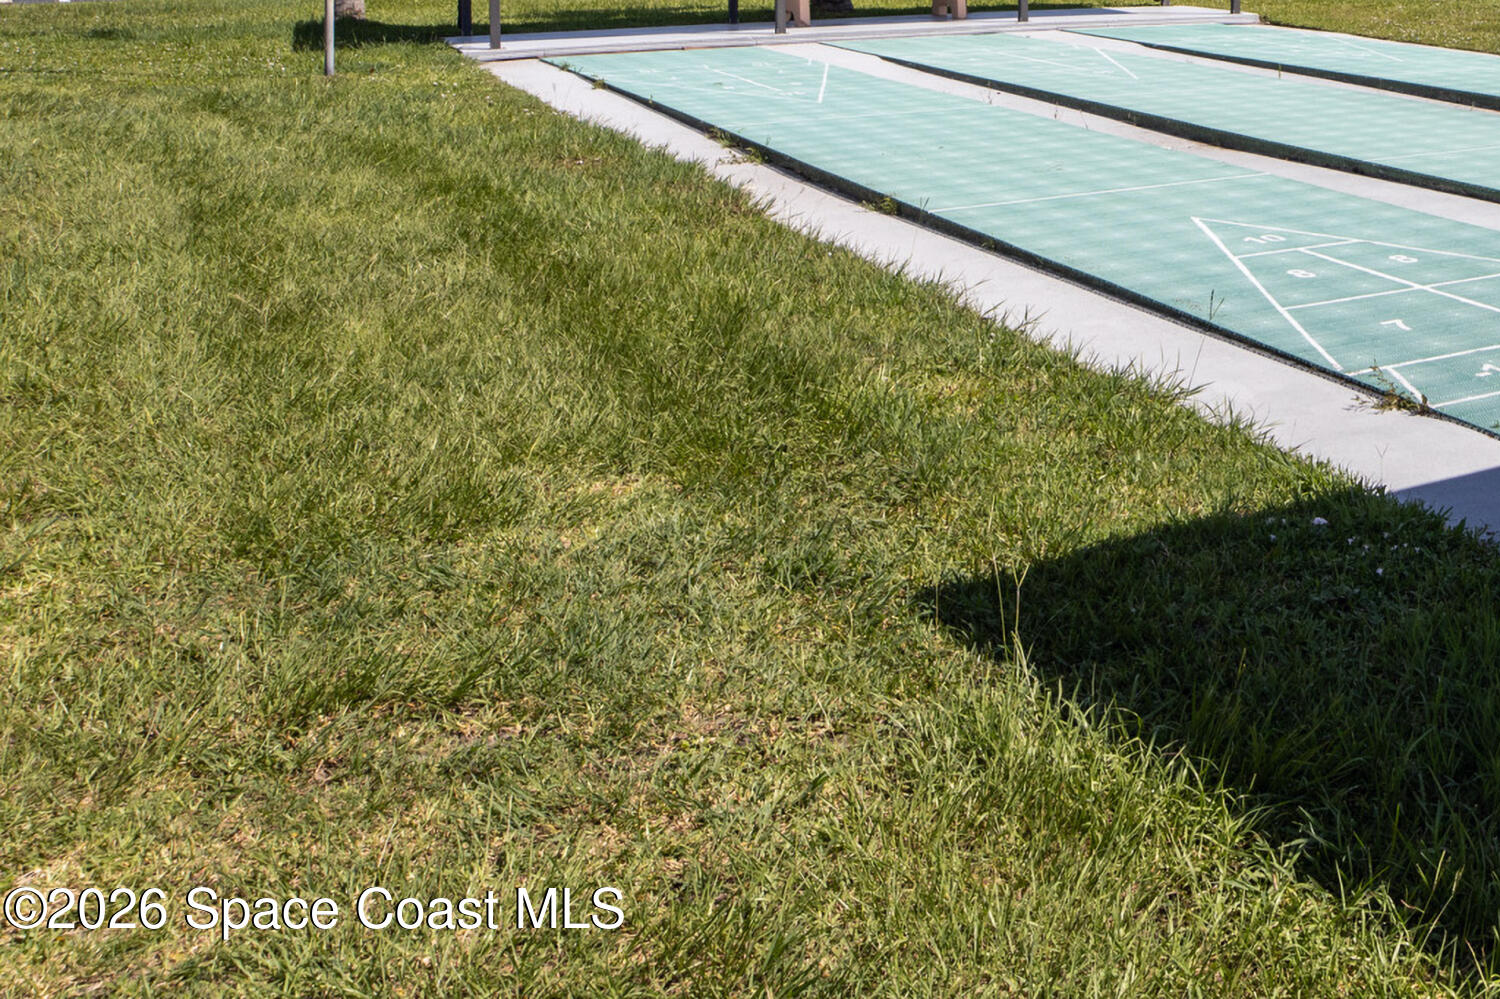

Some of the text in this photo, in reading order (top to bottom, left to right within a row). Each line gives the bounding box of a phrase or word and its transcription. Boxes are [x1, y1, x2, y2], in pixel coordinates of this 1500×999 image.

[1243, 234, 1287, 244] 10
[1388, 254, 1419, 264] 8
[1286, 269, 1317, 279] 8
[1379, 318, 1413, 331] 7
